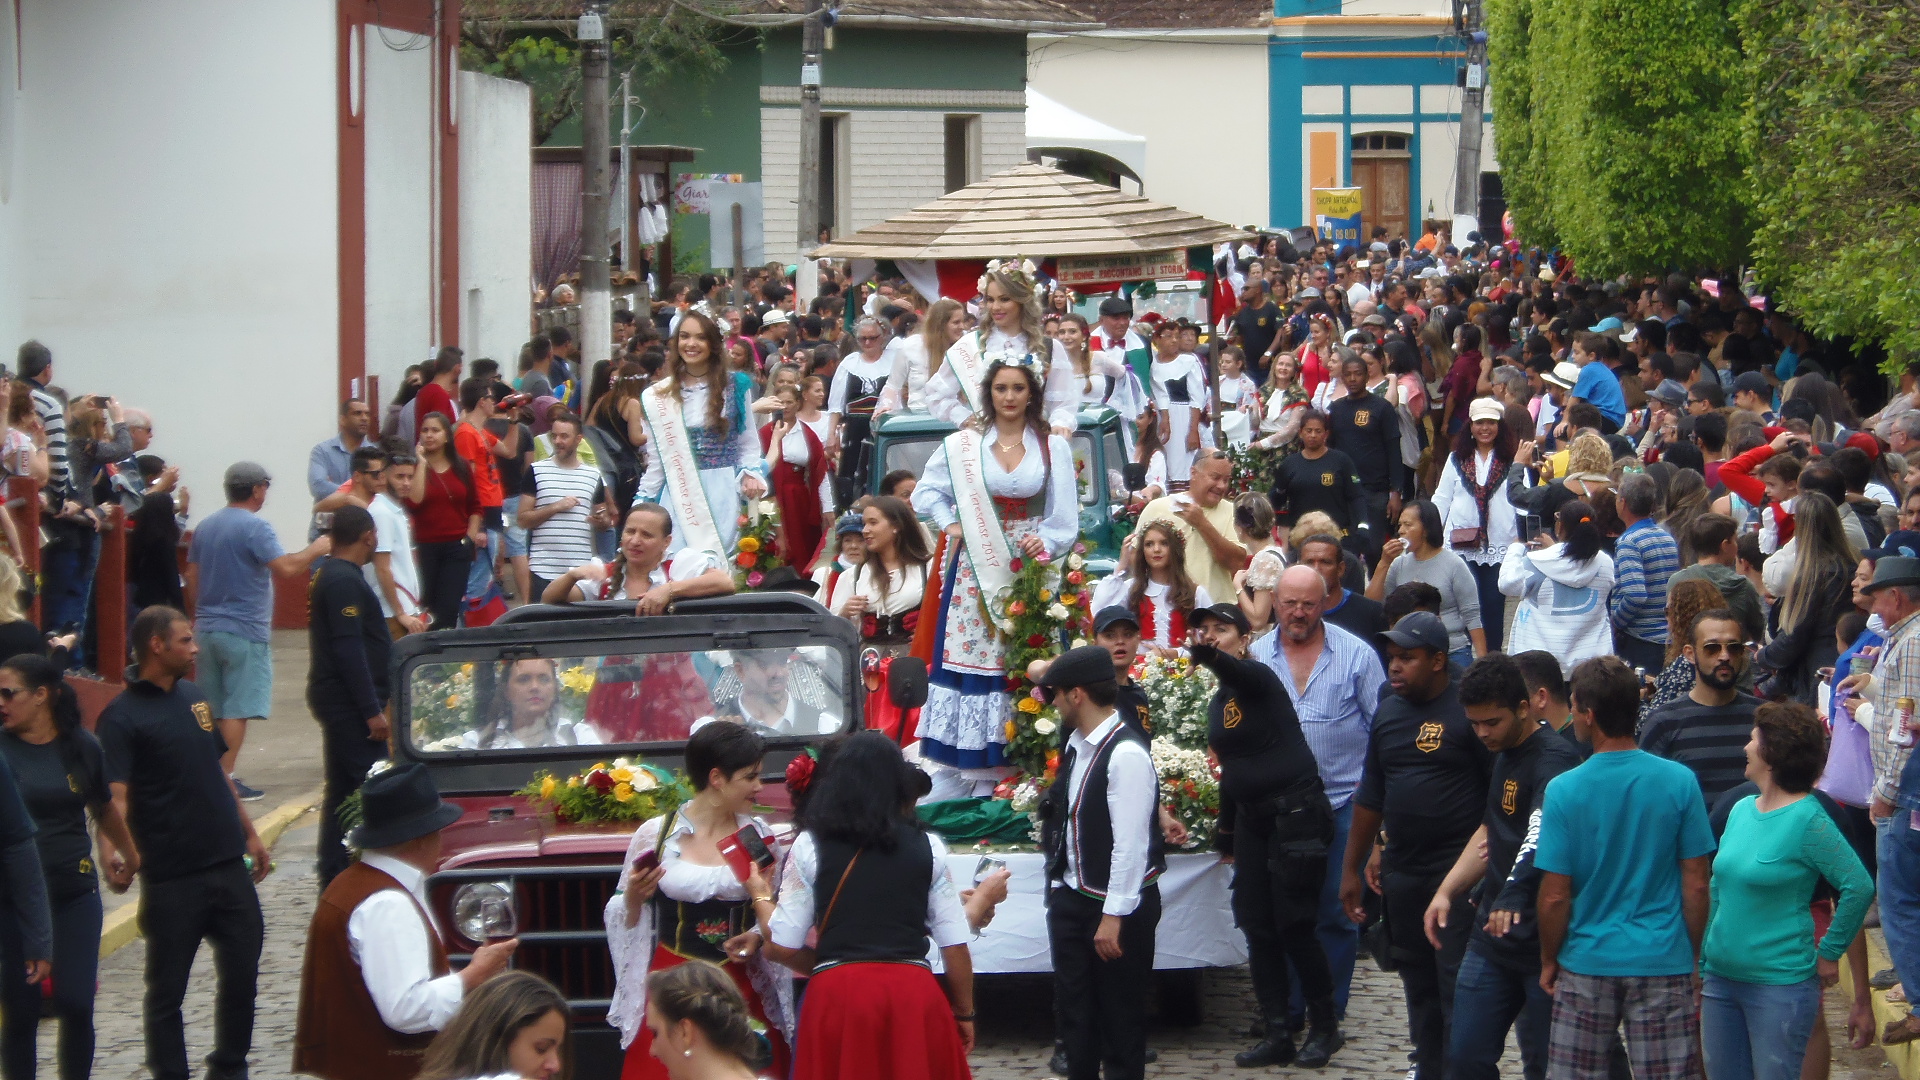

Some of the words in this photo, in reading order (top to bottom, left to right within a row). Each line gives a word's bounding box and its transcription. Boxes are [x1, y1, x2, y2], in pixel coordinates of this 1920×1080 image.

[683, 186, 710, 201] Giar
[1146, 265, 1156, 276] LA
[1160, 263, 1185, 275] STORIA
[681, 503, 700, 527] 2017
[981, 543, 1000, 567] 2017
